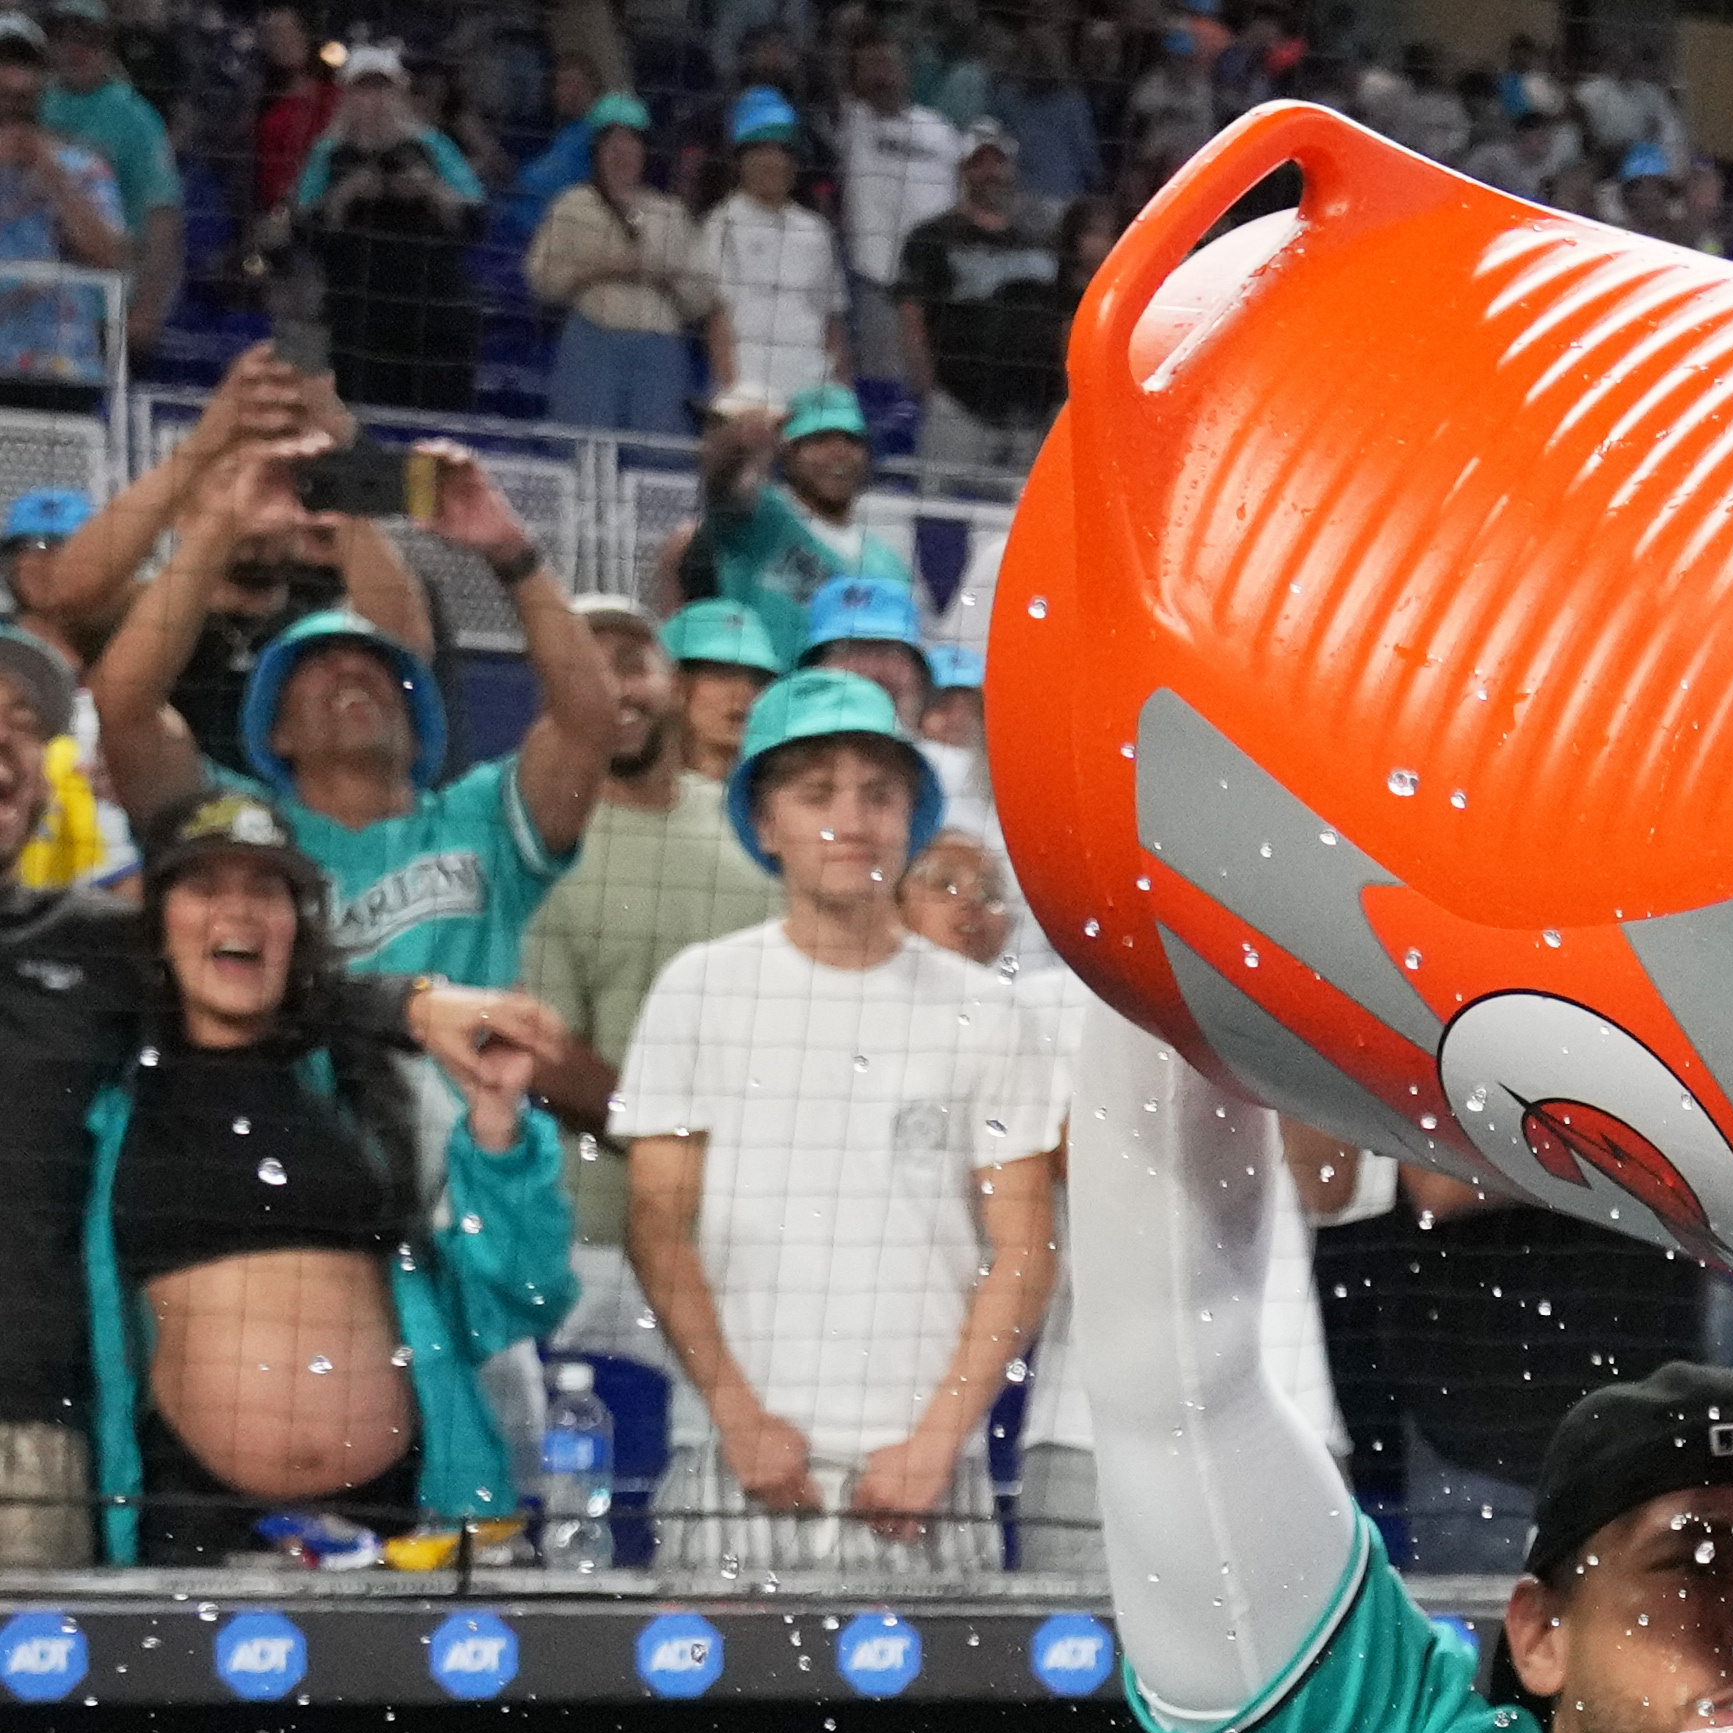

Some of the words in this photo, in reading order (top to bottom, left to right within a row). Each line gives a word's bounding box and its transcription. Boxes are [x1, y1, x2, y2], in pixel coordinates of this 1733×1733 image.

[8, 1637, 75, 1674] ADT
[228, 1637, 295, 1674] ADT
[442, 1637, 507, 1673] ADT
[850, 1636, 911, 1671] ADT
[1042, 1636, 1104, 1670] ADT
